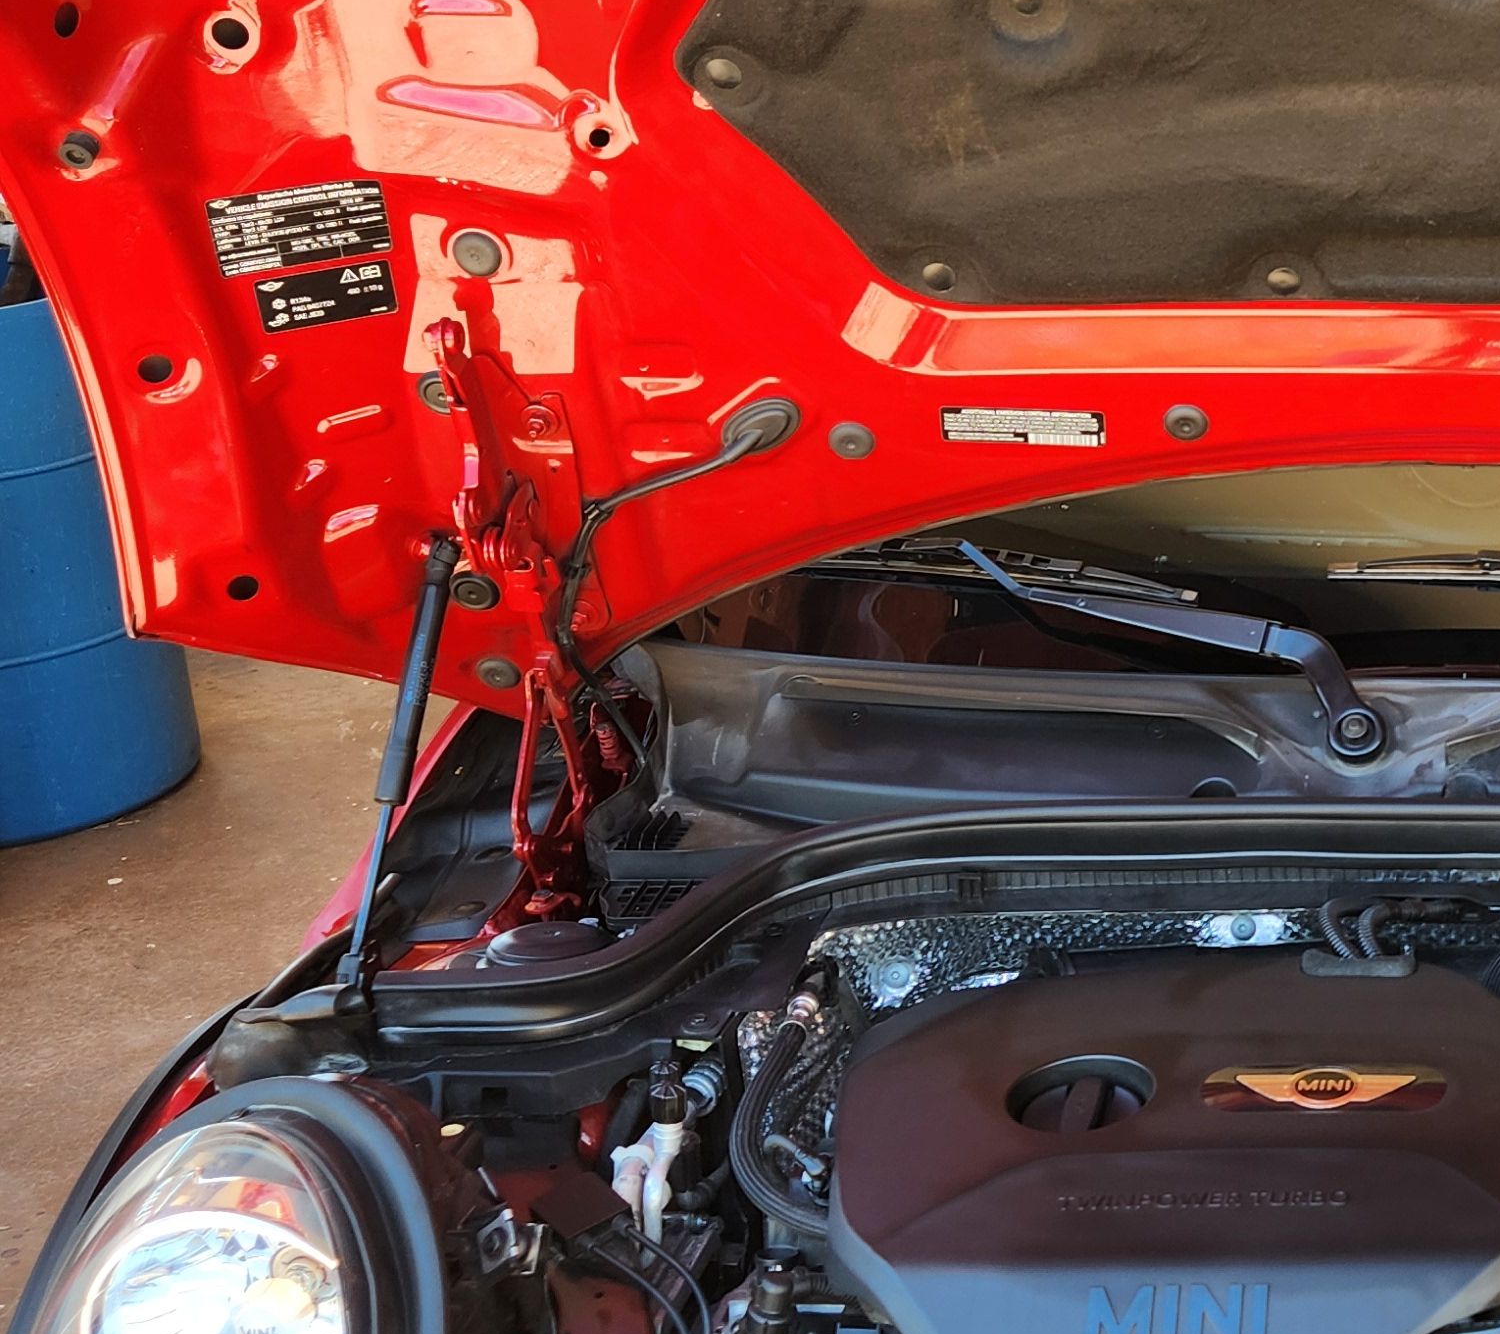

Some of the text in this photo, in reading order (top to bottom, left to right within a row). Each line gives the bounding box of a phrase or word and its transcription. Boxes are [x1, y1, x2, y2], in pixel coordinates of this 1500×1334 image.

[225, 203, 256, 214] VEHICLE
[293, 193, 327, 204] CONTROL
[1297, 1079, 1351, 1092] MINI
[1058, 1189, 1349, 1211] TWINPOWER TURBO
